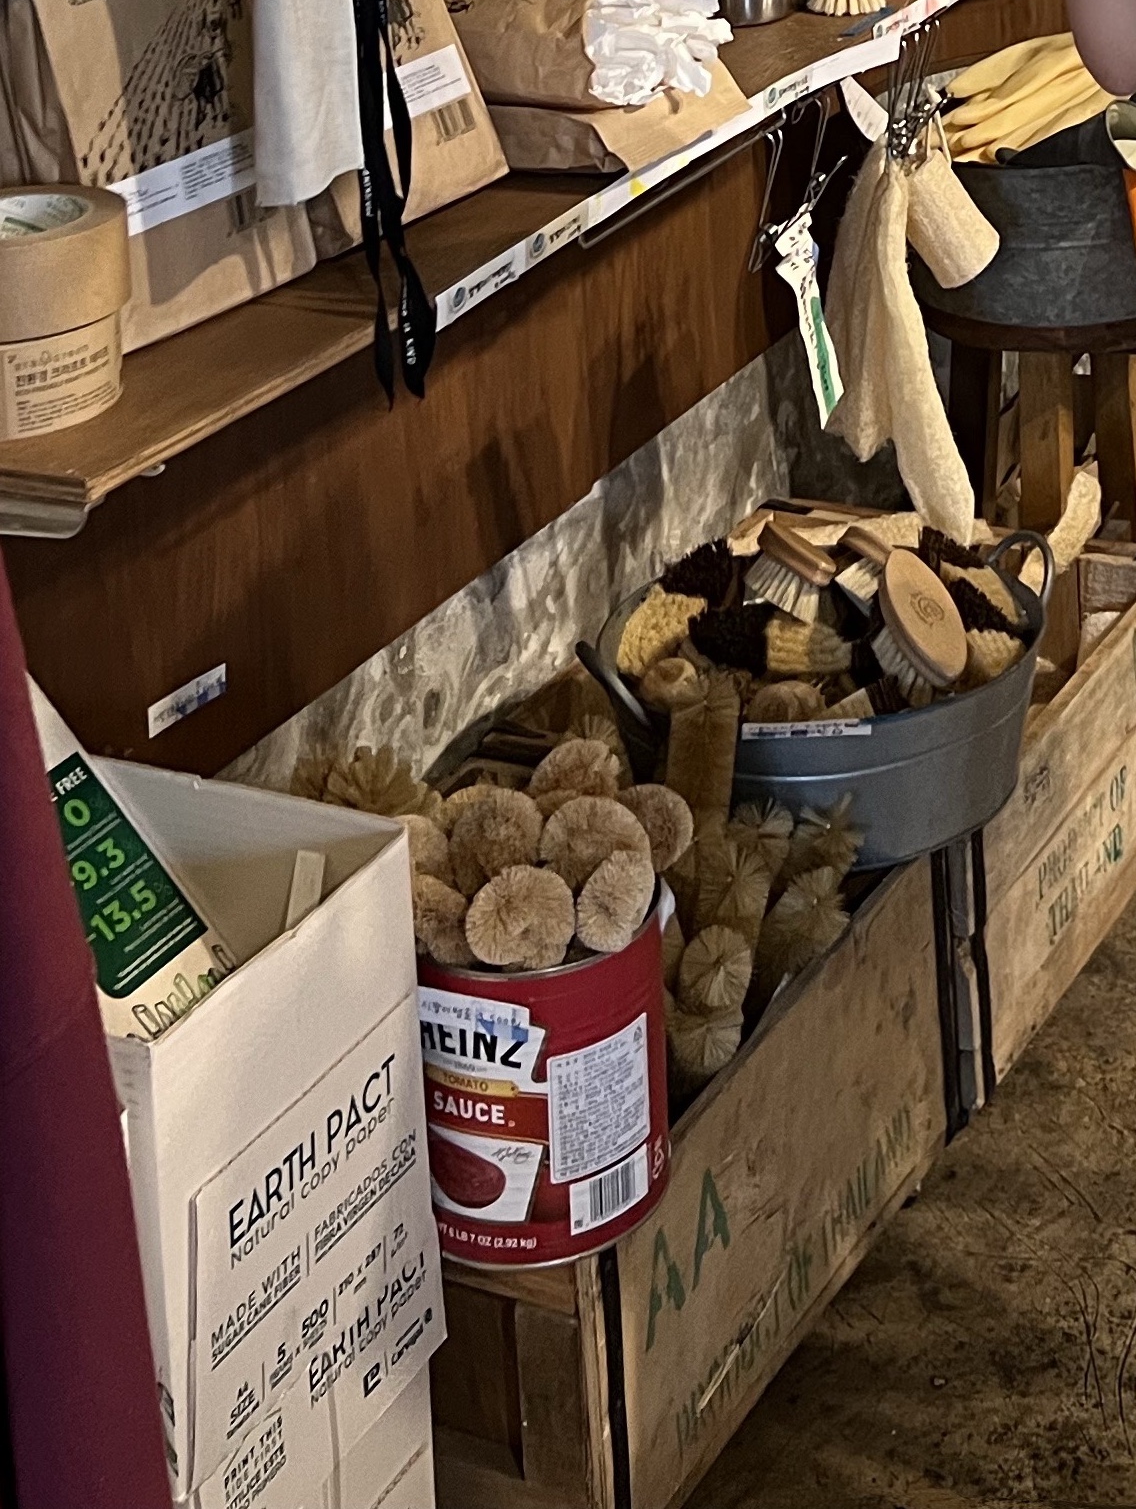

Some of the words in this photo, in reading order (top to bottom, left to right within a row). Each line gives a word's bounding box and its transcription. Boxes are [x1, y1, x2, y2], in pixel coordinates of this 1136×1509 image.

[55, 765, 88, 796] FREE
[419, 1019, 522, 1070] HEINZ
[433, 1091, 506, 1125] SAUCE
[443, 1071, 489, 1092] TOMATO
[229, 1130, 316, 1250] EARTH
[326, 1053, 396, 1154] PACT
[230, 1192, 295, 1271] Natural
[301, 1151, 341, 1200] copy
[345, 1097, 395, 1162] paper
[314, 1160, 388, 1242] FABRICADOS
[391, 1128, 417, 1162] CON
[456, 1227, 468, 1241] LB
[477, 1234, 492, 1247] OZ
[493, 1235, 519, 1250] (2.92
[519, 1236, 537, 1250] kg)
[211, 1289, 257, 1349] MADE
[261, 1245, 301, 1295] WITH
[277, 1341, 286, 1364] 5
[302, 1298, 329, 1339] 500
[223, 1444, 256, 1491] PRINT
[258, 1414, 283, 1449] THIS
